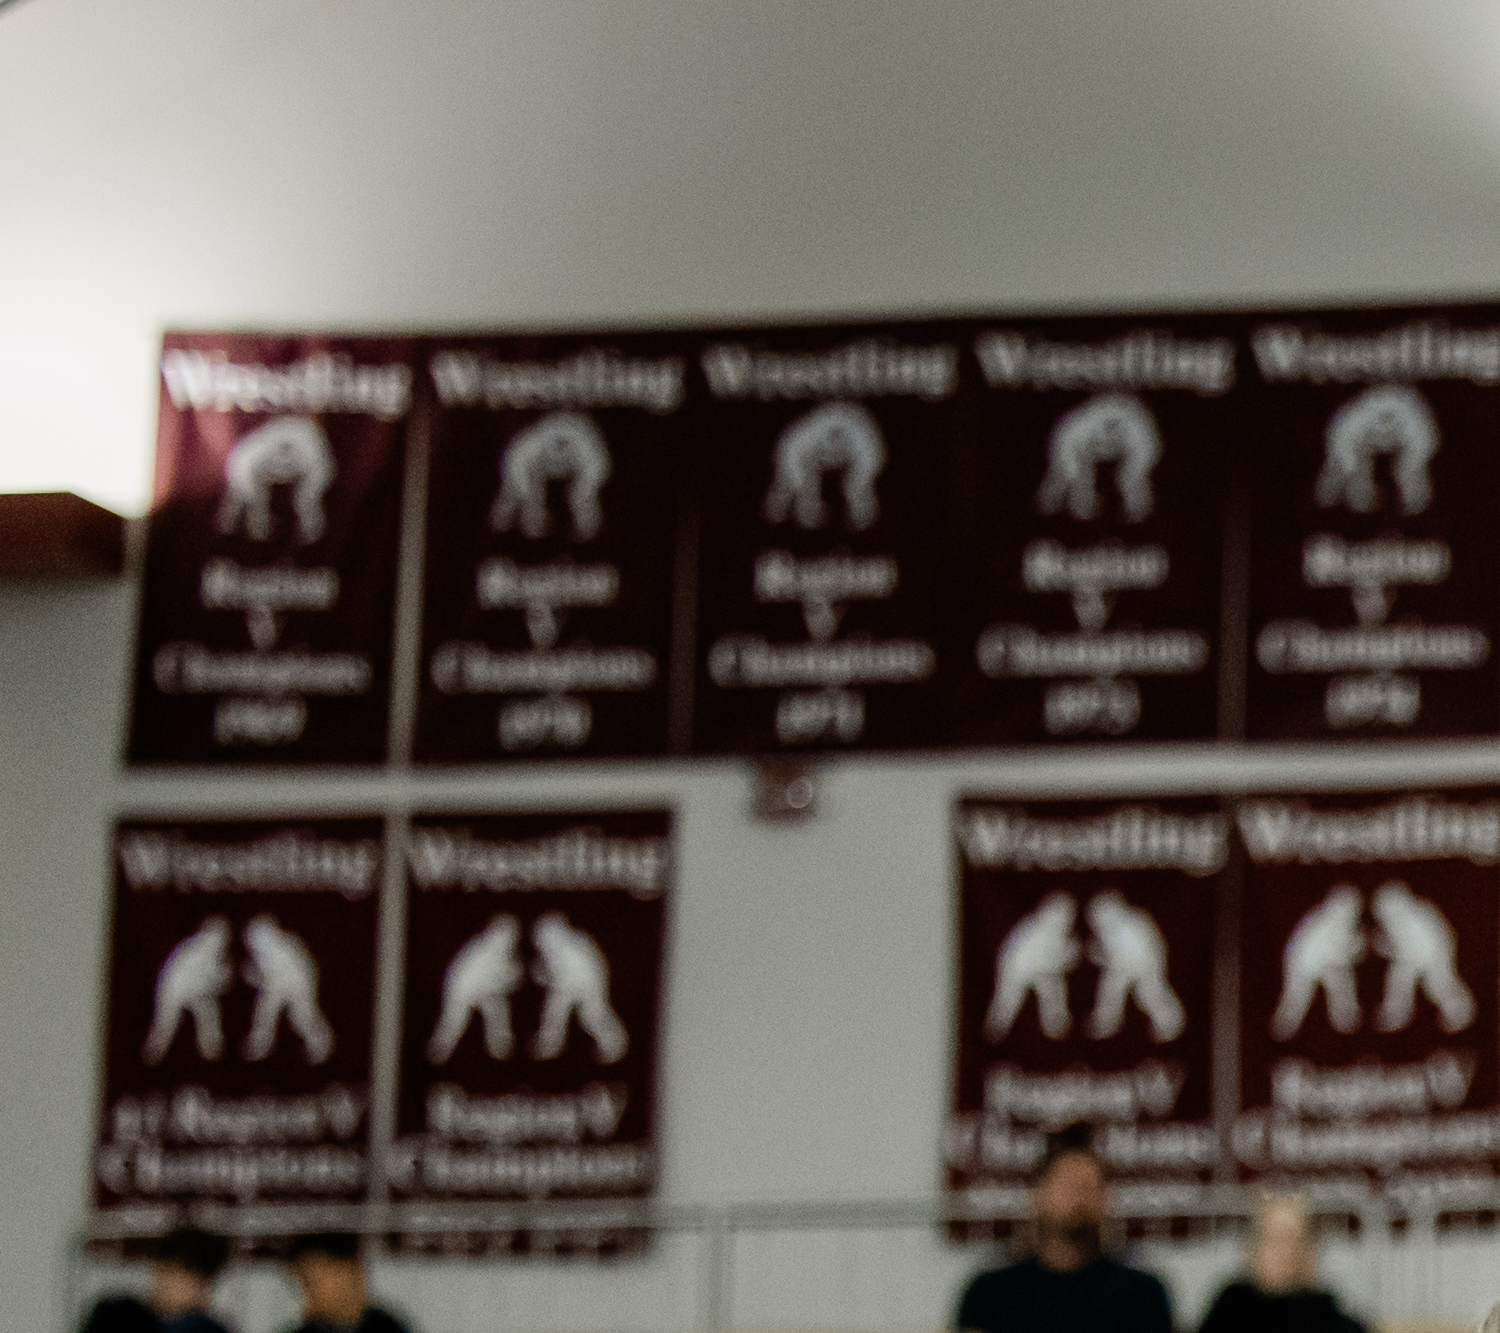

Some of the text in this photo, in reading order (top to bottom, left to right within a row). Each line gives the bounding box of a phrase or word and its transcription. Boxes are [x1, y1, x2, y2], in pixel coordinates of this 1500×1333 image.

[162, 346, 412, 420] Wrestling
[430, 348, 688, 414] Wrestling
[701, 340, 959, 398] Wrestling
[974, 327, 1237, 396] Wrestling
[119, 830, 378, 898] Wrestling
[406, 826, 666, 899] Wrestling
[964, 808, 1228, 877] Wrestling
